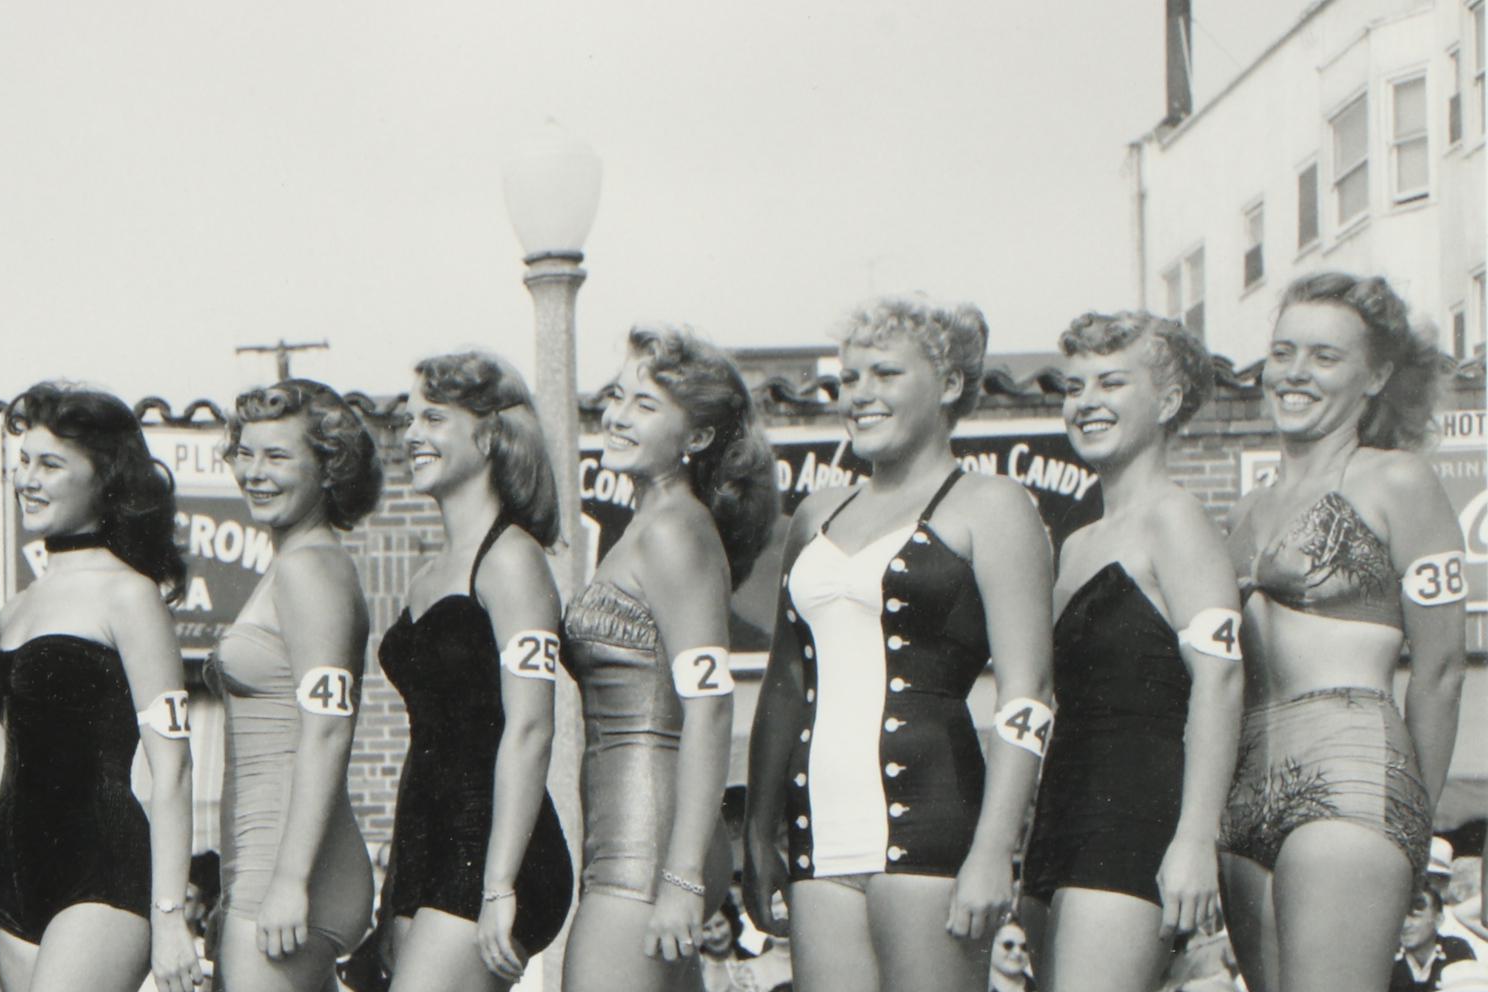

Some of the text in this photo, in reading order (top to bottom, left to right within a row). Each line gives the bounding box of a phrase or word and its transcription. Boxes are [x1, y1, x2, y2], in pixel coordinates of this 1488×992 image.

[1007, 442, 1099, 501] CANDY
[1415, 556, 1464, 600] 38
[1212, 617, 1236, 653] 4
[517, 635, 559, 674] 25
[693, 653, 719, 690] 2
[308, 674, 349, 711] 41
